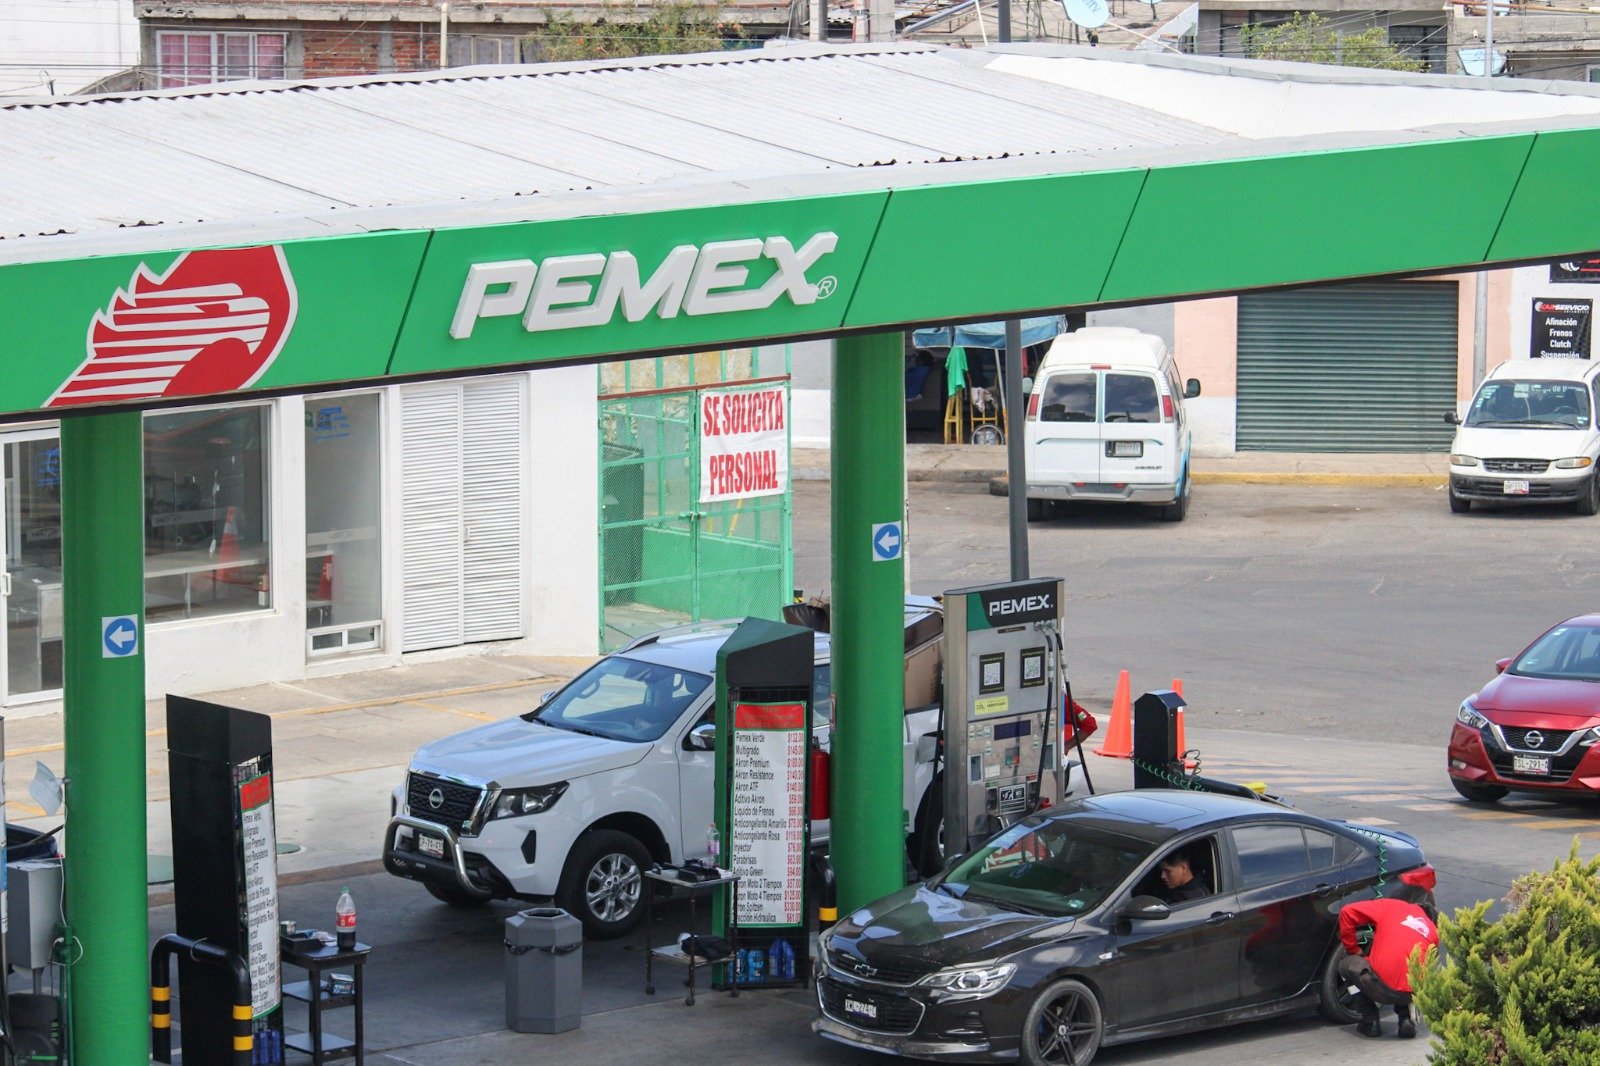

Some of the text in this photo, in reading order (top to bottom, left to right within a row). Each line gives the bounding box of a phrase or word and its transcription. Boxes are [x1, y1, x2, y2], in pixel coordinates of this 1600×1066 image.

[449, 231, 838, 339] PEMEX
[1545, 317, 1578, 326] Afinación
[1549, 328, 1573, 337] Frenos
[1549, 339, 1572, 348] Clutch
[1540, 350, 1580, 359] Suspensión
[703, 390, 784, 437] SE SOLICITA
[709, 449, 778, 496] PERSONAL
[989, 594, 1050, 617] PEMEX
[736, 732, 751, 742] Pemex
[752, 733, 765, 743] Verde
[736, 745, 760, 757] Multigrado
[735, 759, 749, 768] Akron
[750, 757, 770, 768] Premium
[735, 770, 749, 780] Akron
[750, 769, 774, 780] Resistence
[735, 782, 749, 792] Akron
[750, 781, 759, 792] ATF
[735, 794, 750, 804] Aditivo
[751, 794, 765, 804] Akron
[752, 806, 758, 816] de
[759, 805, 775, 816] Frenos
[735, 818, 768, 830] Anticongelante
[768, 818, 787, 828] Amarillo
[734, 831, 768, 842] Anticongelante
[768, 830, 780, 841] Rosa
[733, 854, 757, 864] Parabrisas
[750, 866, 764, 876] Green
[747, 879, 758, 888] Moto
[759, 879, 763, 888] 2
[763, 878, 782, 890] Tiempos
[747, 891, 758, 901] Moto
[759, 891, 763, 900] 4
[763, 890, 782, 902] Tiempos
